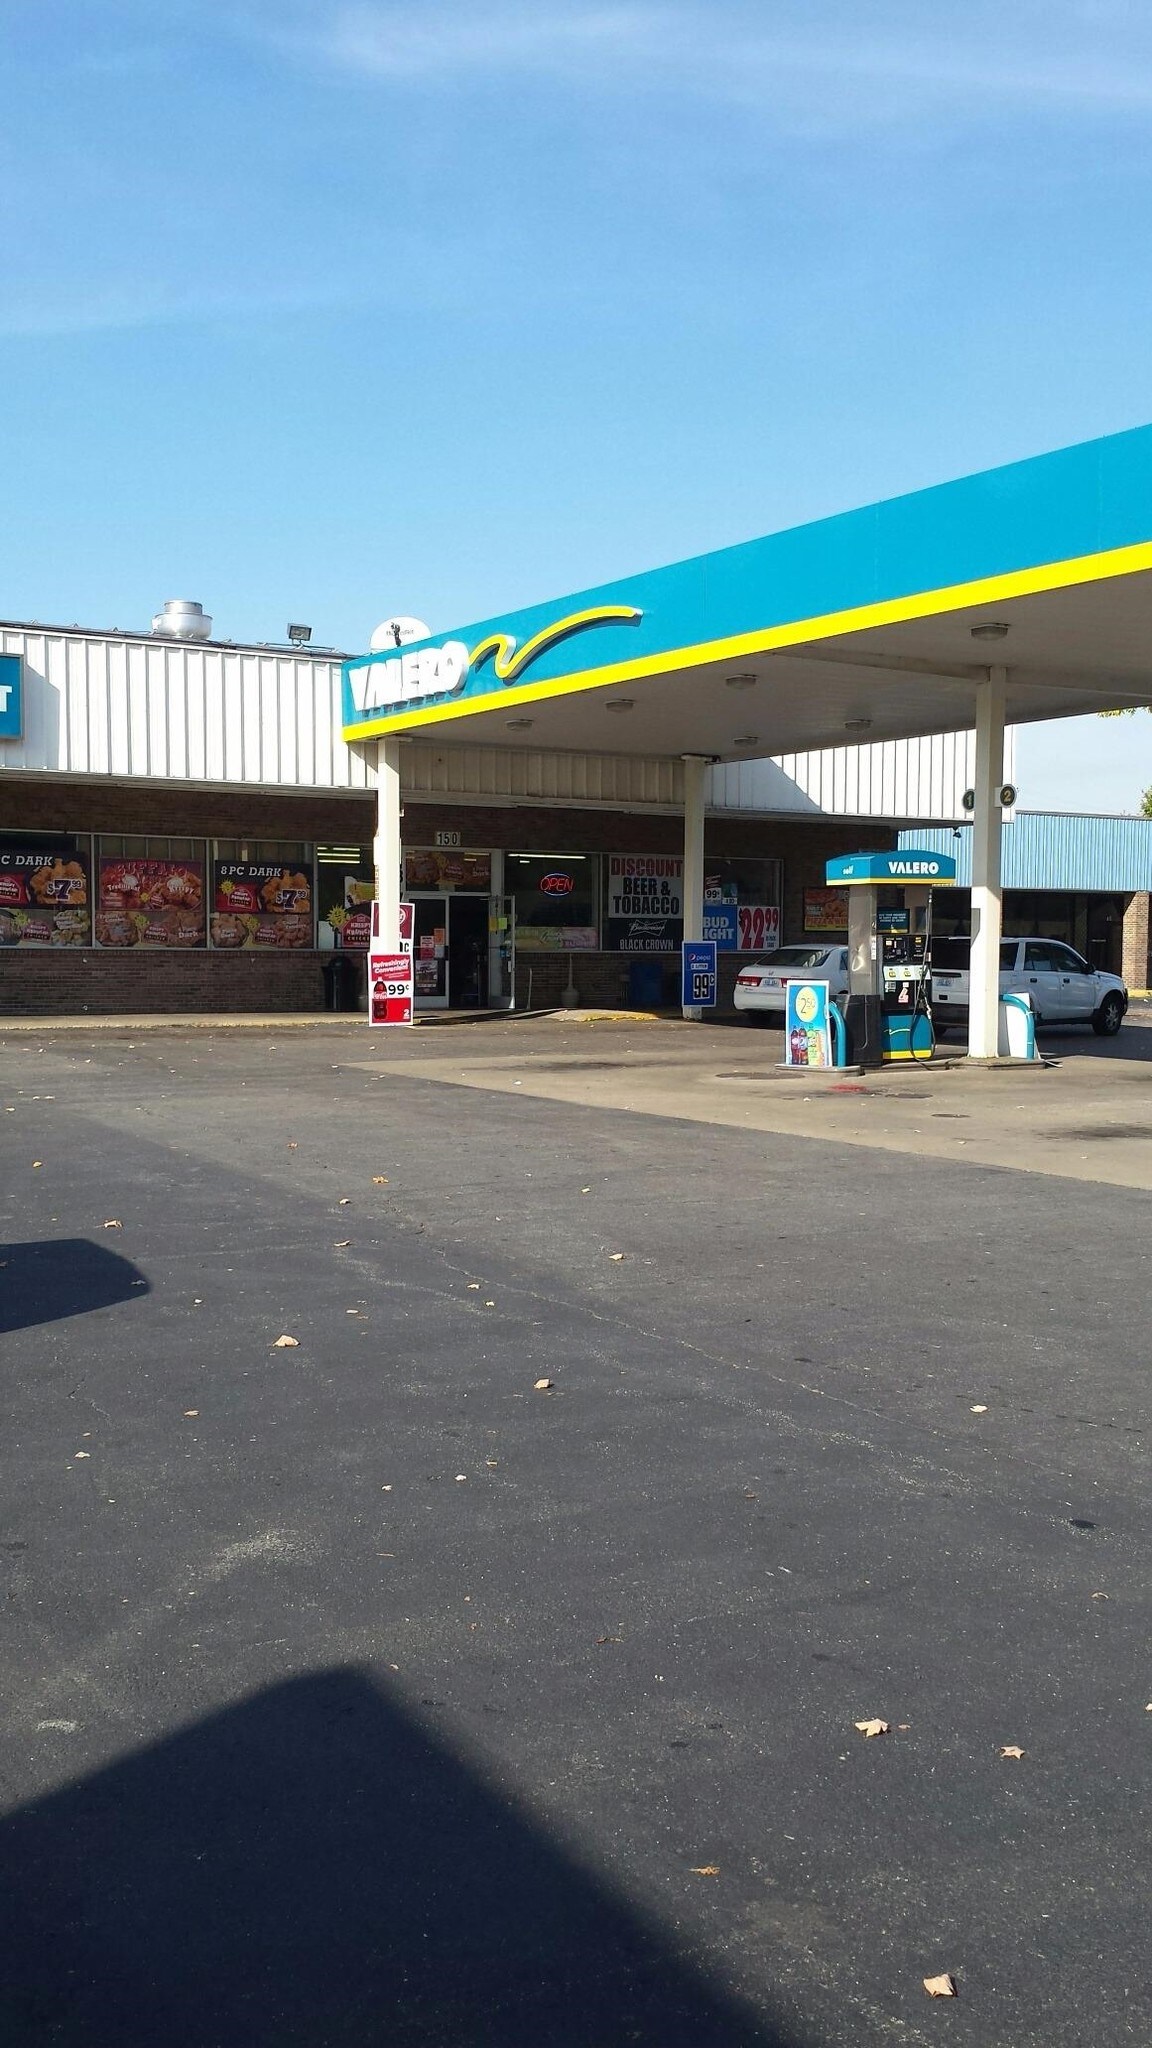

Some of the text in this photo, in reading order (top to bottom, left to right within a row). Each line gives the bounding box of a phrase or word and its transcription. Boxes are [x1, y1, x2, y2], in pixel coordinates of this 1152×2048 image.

[348, 641, 469, 712] VALERO
[1004, 790, 1011, 802] 2
[438, 833, 458, 844] 150
[15, 856, 53, 866] DARK
[249, 867, 281, 876] DARK
[611, 857, 684, 877] DISCOUNT
[888, 861, 939, 874] VALERO
[541, 878, 573, 892] OPEN
[623, 877, 671, 896] BEER &
[612, 896, 680, 915] TOBACCO
[703, 917, 730, 928] BUD
[703, 929, 734, 939] IGHT
[620, 939, 673, 950] BLACK CROWN
[403, 1008, 410, 1017] 2
